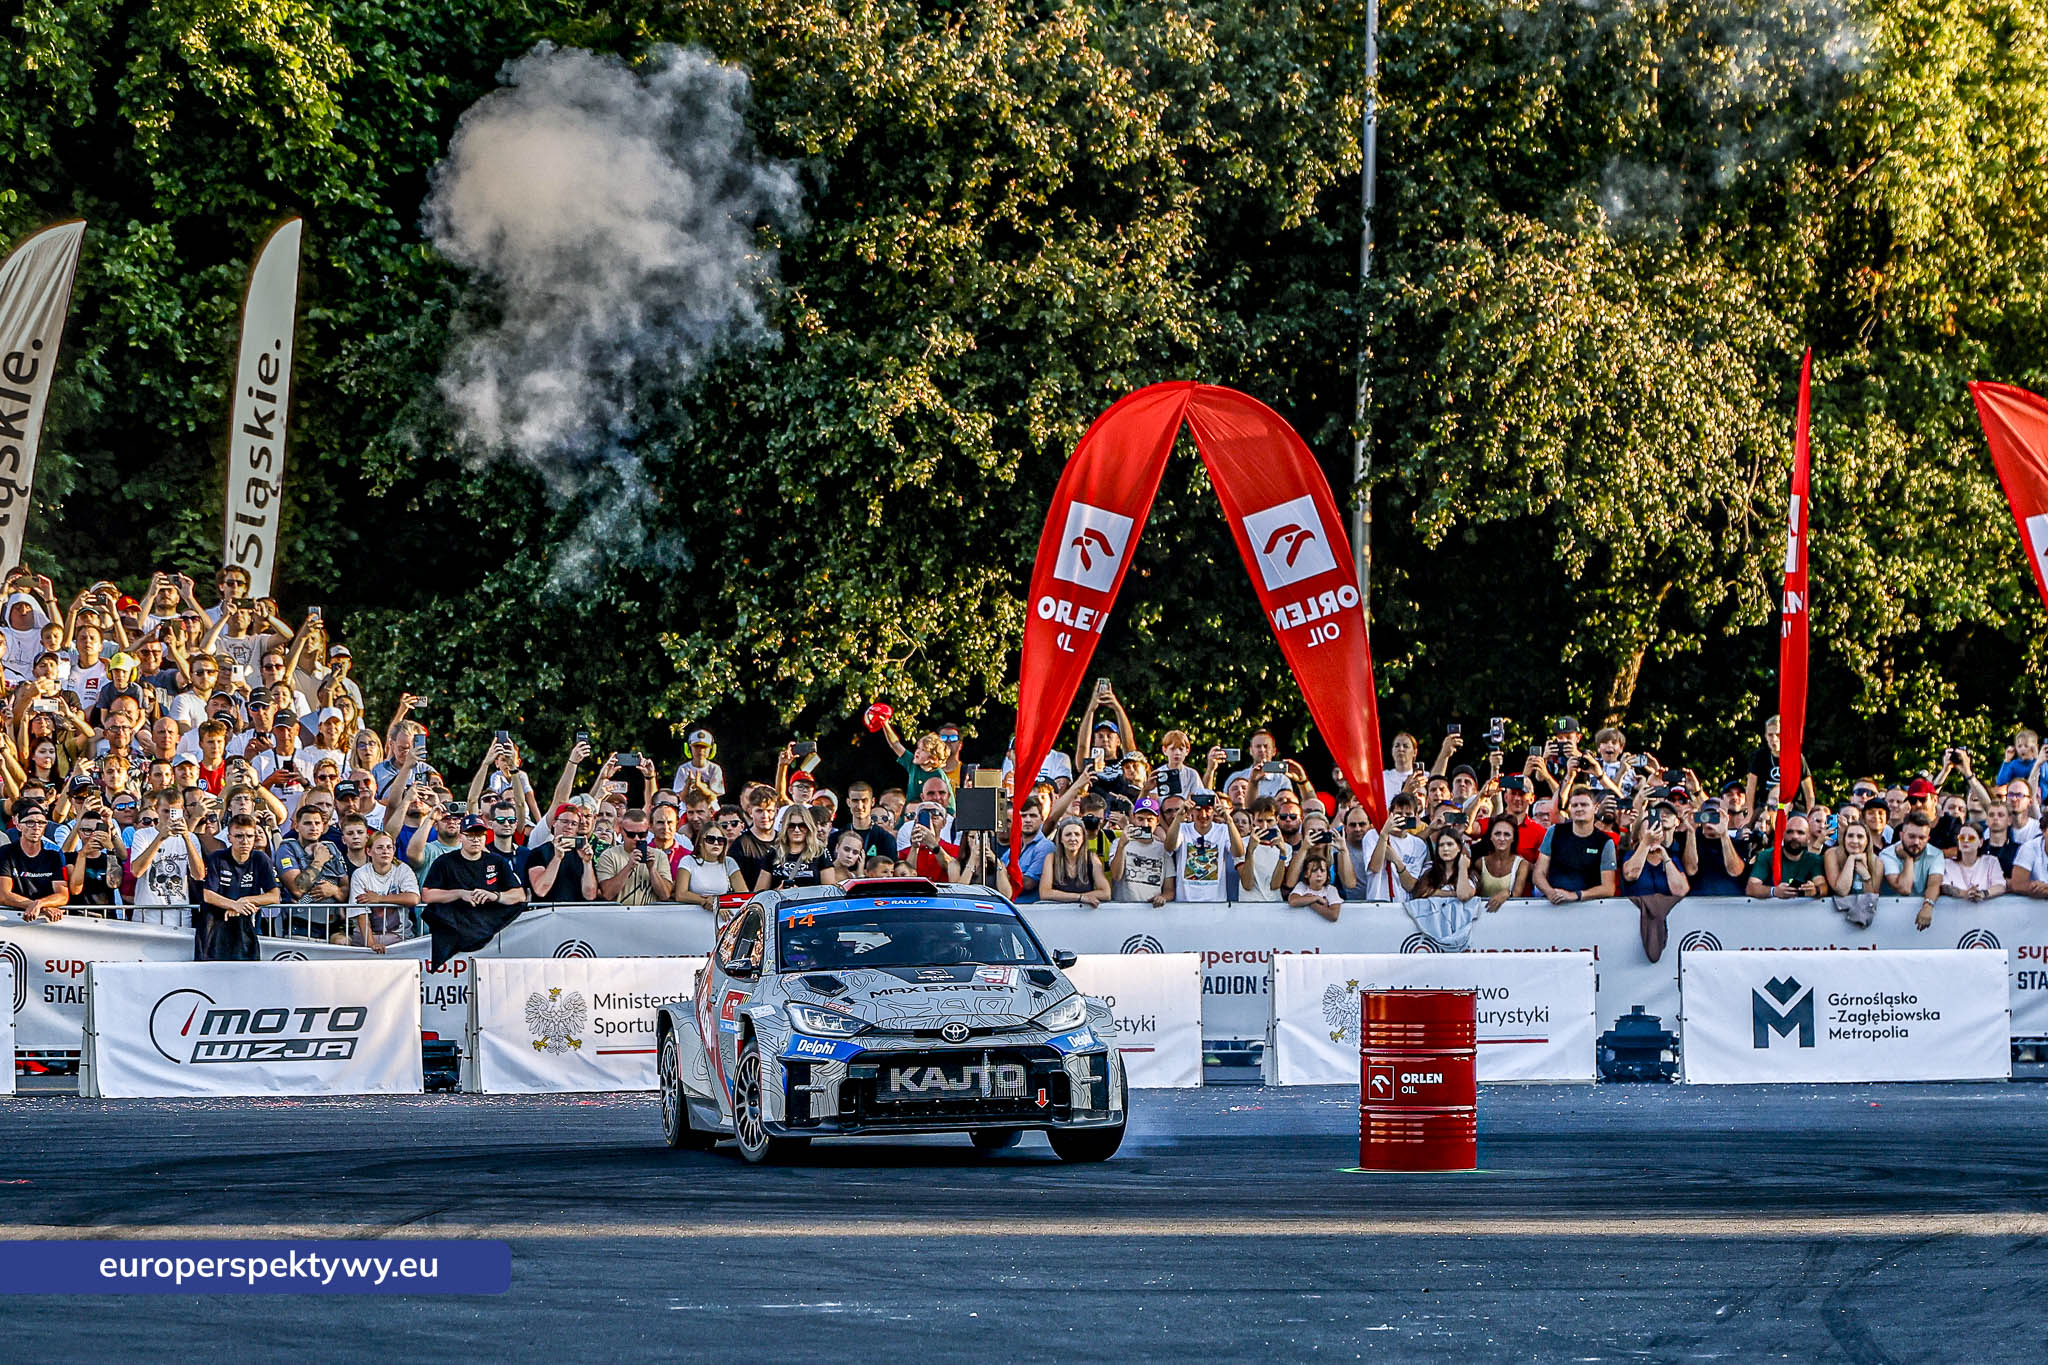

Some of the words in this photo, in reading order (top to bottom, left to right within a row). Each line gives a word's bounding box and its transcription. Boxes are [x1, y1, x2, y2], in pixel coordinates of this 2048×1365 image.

[230, 338, 282, 569] Śląskie.
[785, 914, 816, 929] 14
[869, 986, 920, 999] MAX
[925, 985, 1017, 994] EXPERT
[1828, 991, 1918, 1008] Górnośląsko
[200, 1006, 367, 1035] MOTO
[1476, 1006, 1549, 1027] urystyki
[594, 1017, 654, 1037] Sportu
[1829, 1027, 1908, 1042] Metropolia
[196, 1041, 352, 1061] WIZJA
[797, 1039, 837, 1055] Delphi
[891, 1064, 1026, 1096] KAJTO
[1401, 1073, 1443, 1084] ORLEN
[1401, 1086, 1417, 1094] OIL
